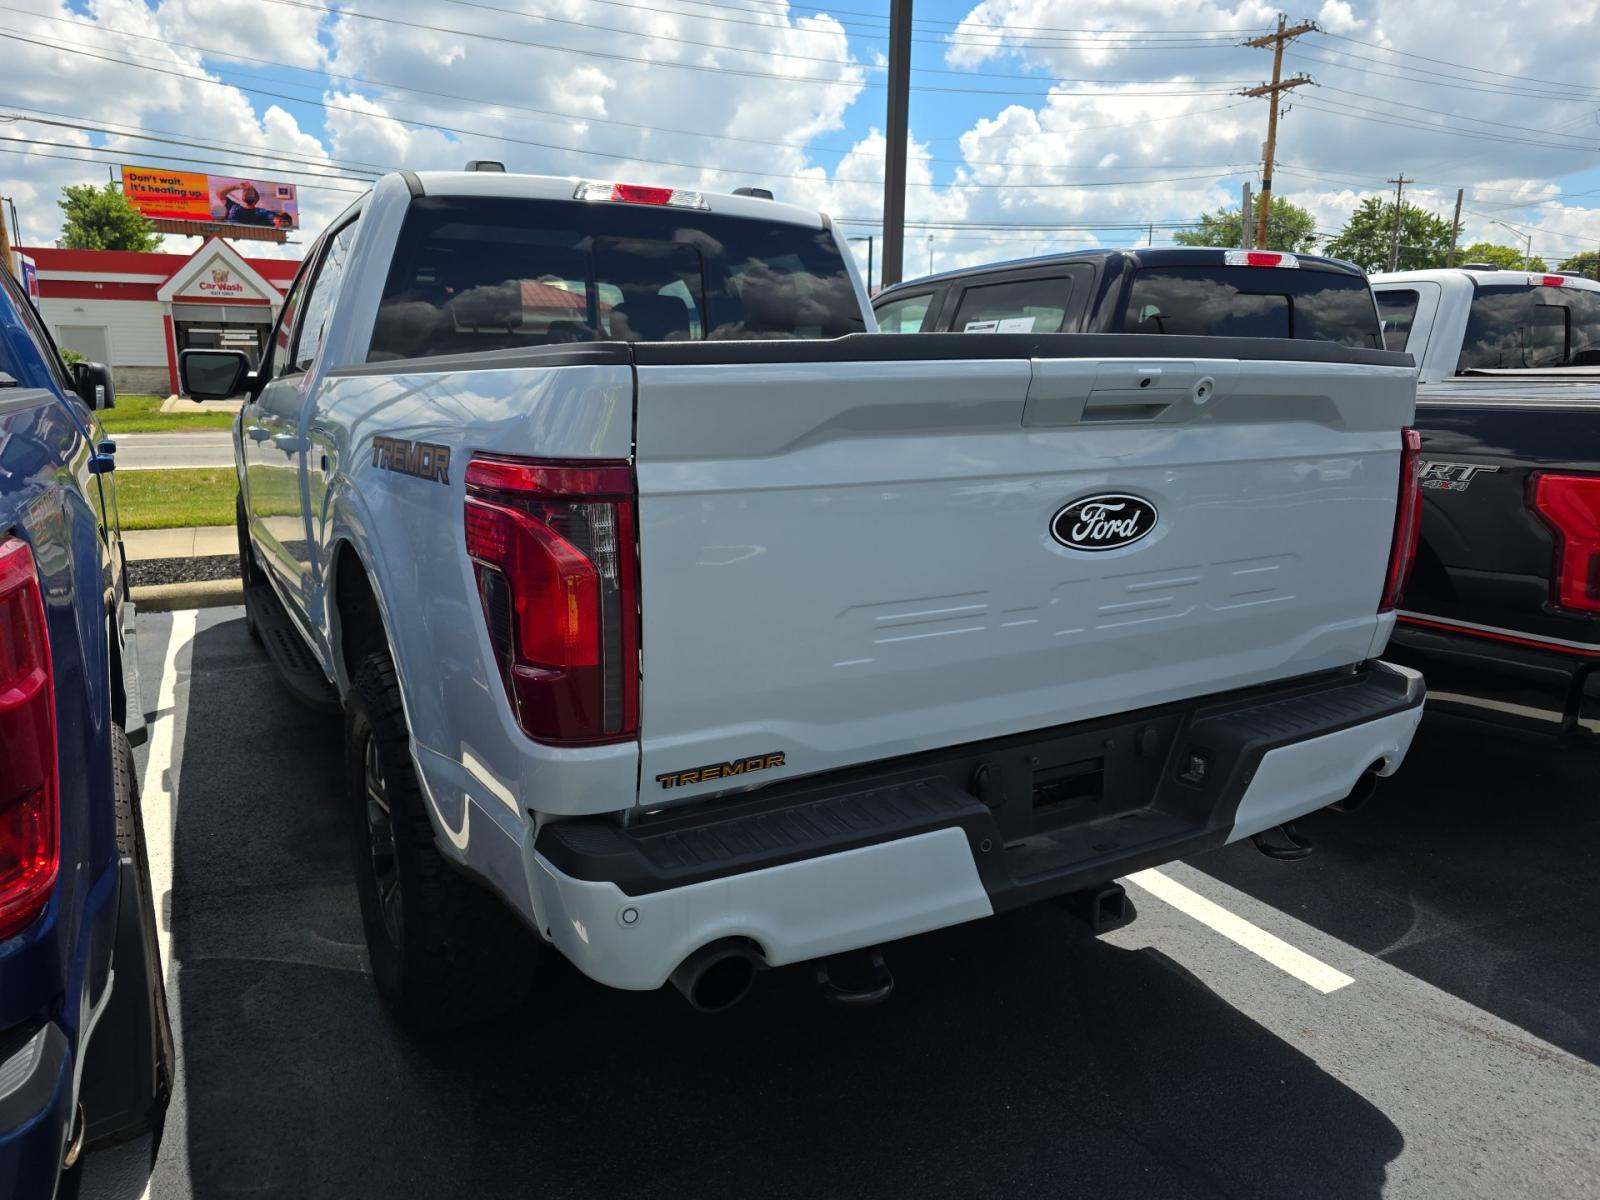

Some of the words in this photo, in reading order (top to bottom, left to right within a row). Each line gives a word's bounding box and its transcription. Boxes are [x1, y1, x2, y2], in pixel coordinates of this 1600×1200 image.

[129, 173, 157, 182] Don't
[159, 176, 184, 186] wait.
[130, 183, 146, 192] It's
[148, 185, 187, 198] heating
[199, 282, 216, 290] Car
[217, 282, 243, 292] Wash
[372, 436, 451, 486] TREMOR
[1072, 502, 1141, 542] Ford
[655, 750, 786, 790] TREMOR
